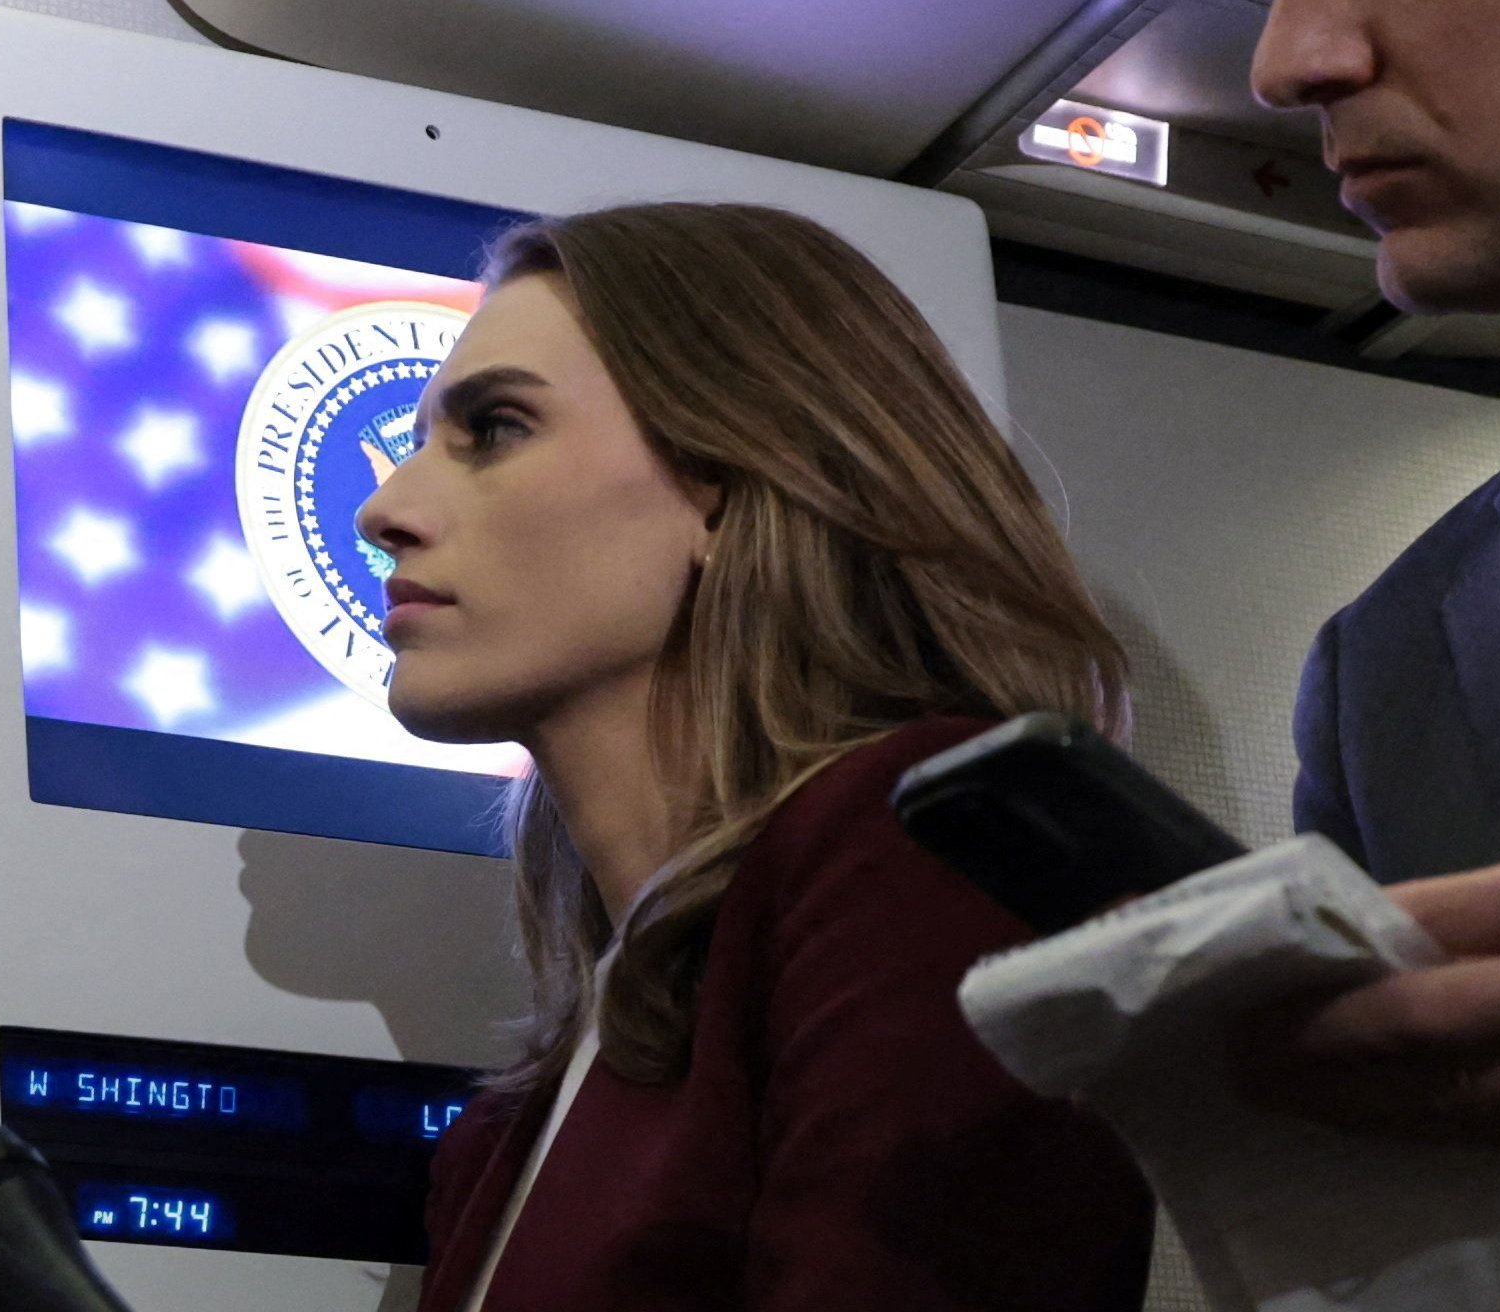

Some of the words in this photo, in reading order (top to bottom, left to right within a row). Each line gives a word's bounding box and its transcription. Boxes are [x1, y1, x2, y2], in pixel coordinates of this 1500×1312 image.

[438, 330, 457, 350] O
[257, 321, 425, 475] PRESIDENT
[320, 603, 396, 687] EAL
[93, 1210, 114, 1225] PM
[129, 1196, 210, 1233] 7:44
